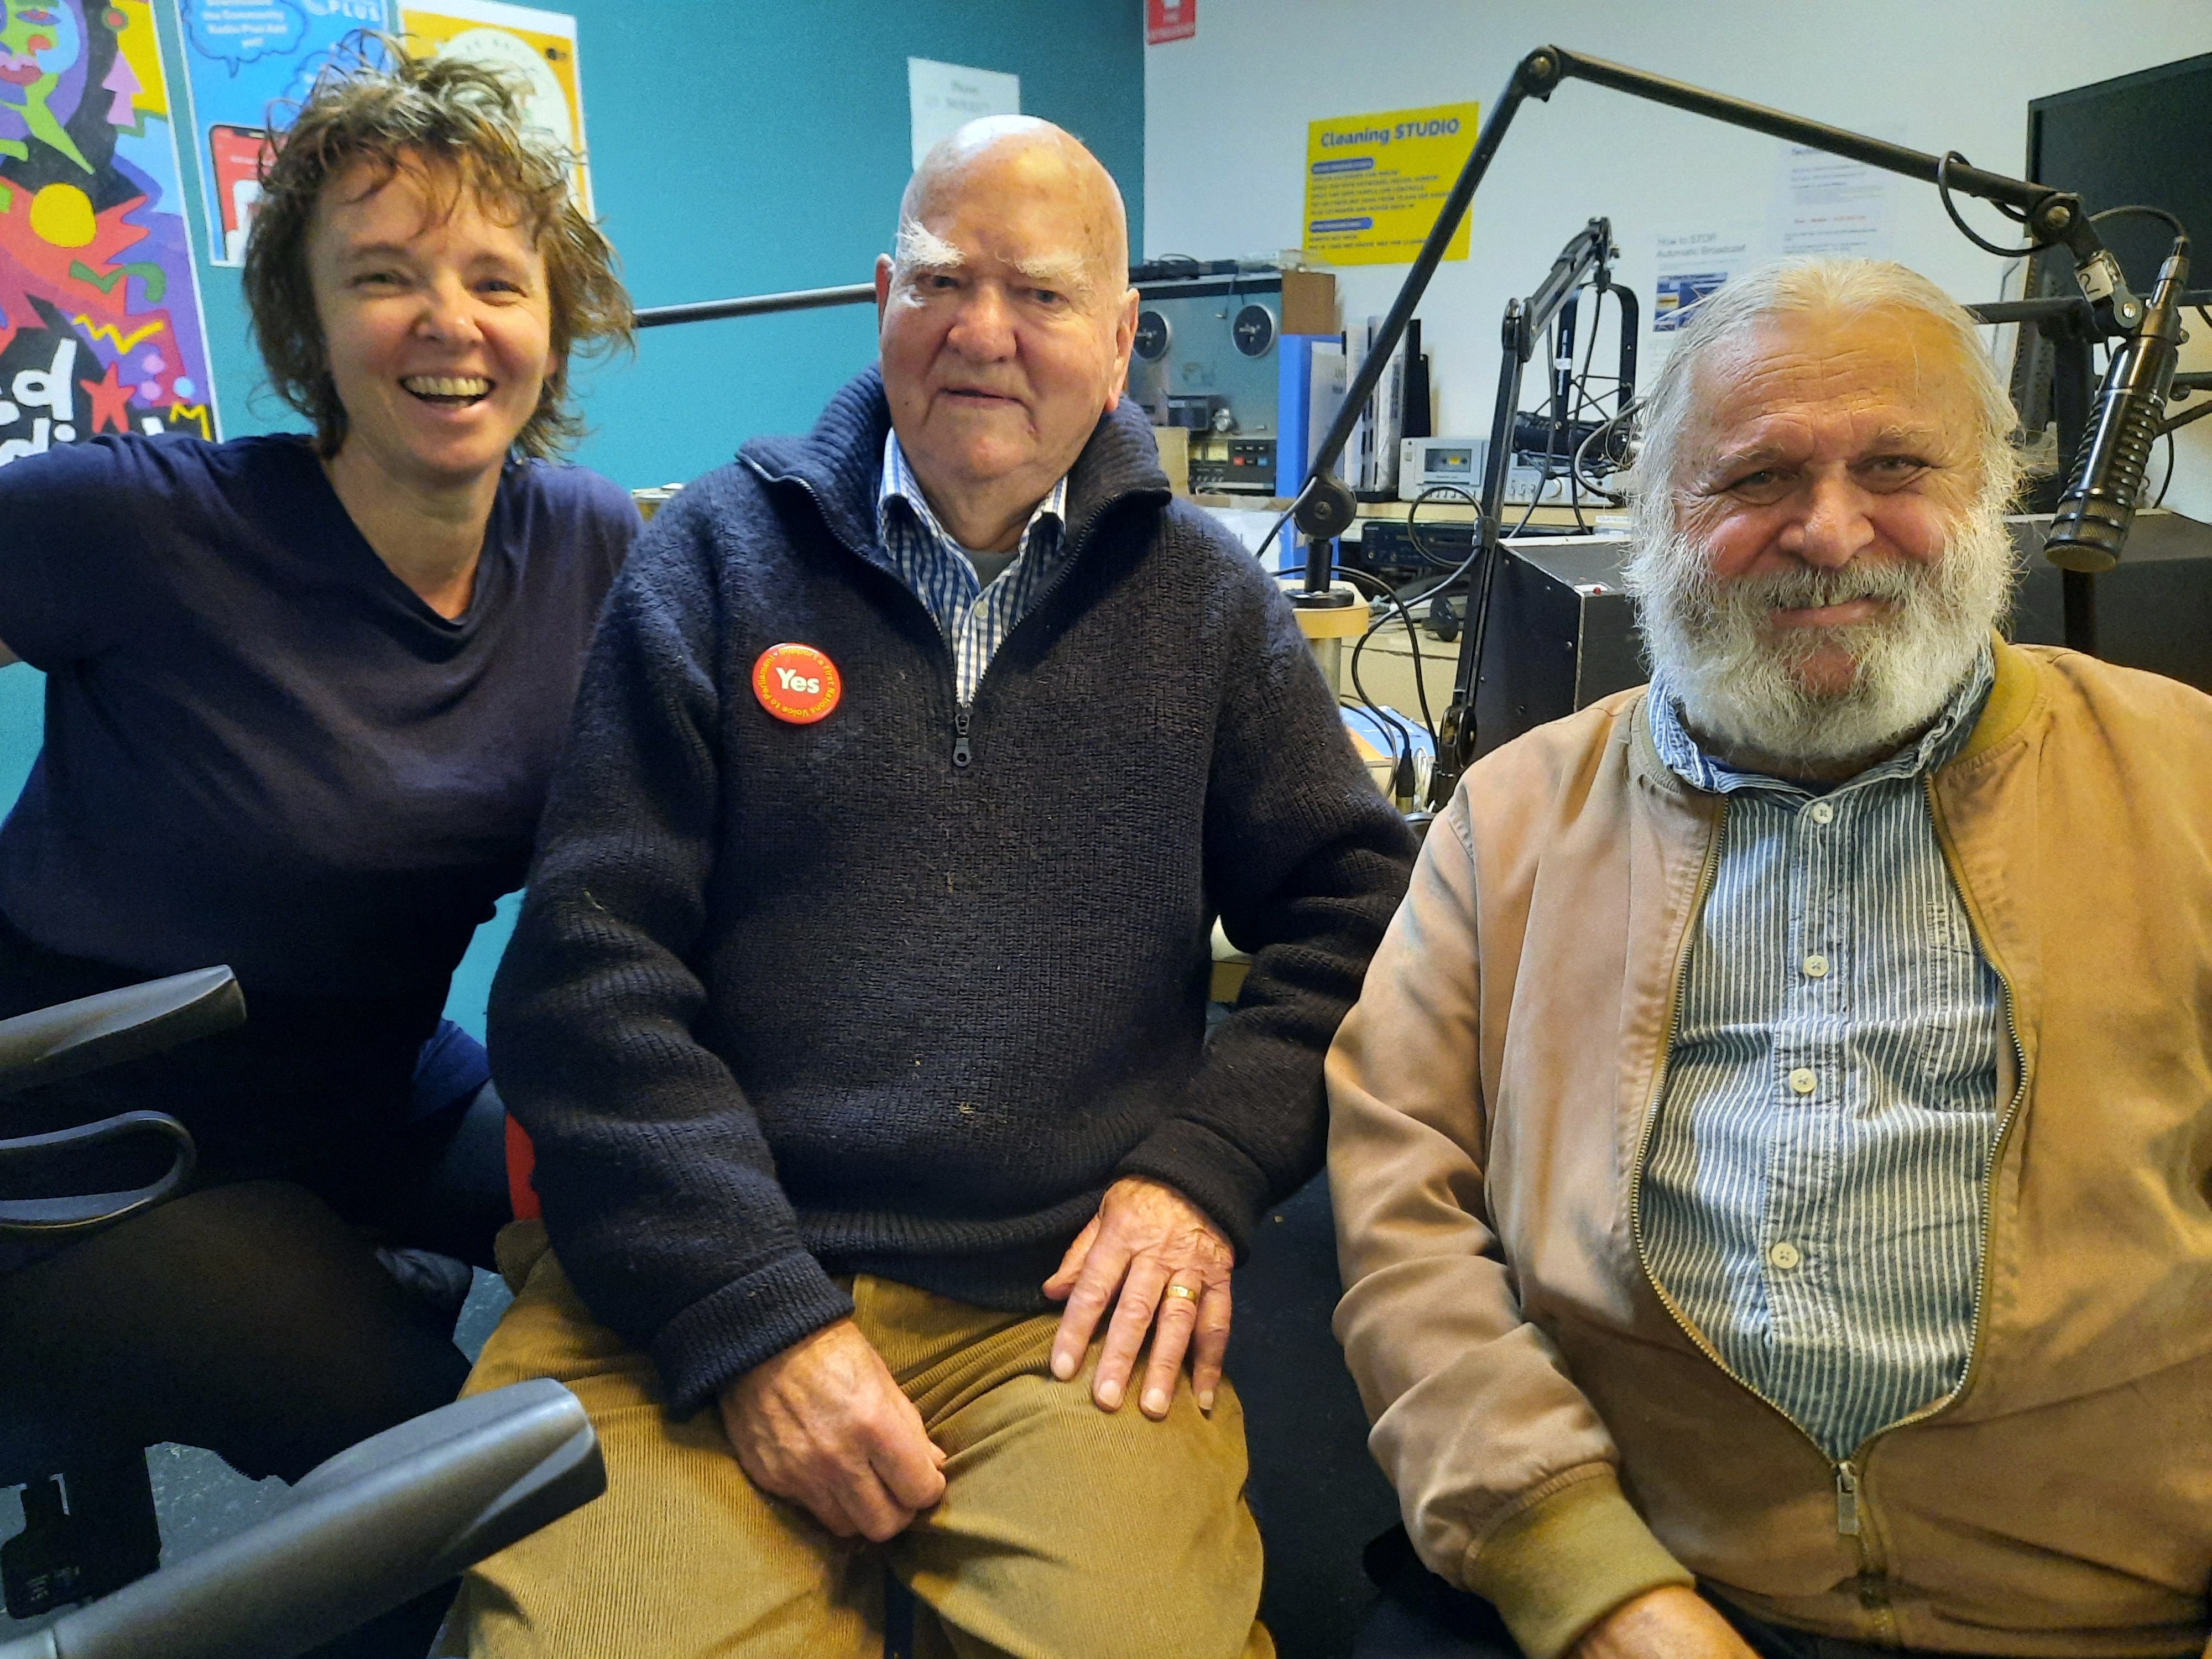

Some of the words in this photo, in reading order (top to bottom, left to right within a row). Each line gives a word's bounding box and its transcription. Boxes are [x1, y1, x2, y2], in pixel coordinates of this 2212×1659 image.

[1321, 128, 1390, 147] Cleaning
[1395, 118, 1461, 139] STUDIO
[2079, 273, 2101, 295] 2
[778, 648, 818, 661] Support
[758, 654, 775, 700] Parliament
[775, 667, 820, 694] Yes
[823, 665, 835, 686] First
[770, 699, 781, 709] to
[782, 706, 809, 717] Voice
[810, 688, 836, 714] Nations
